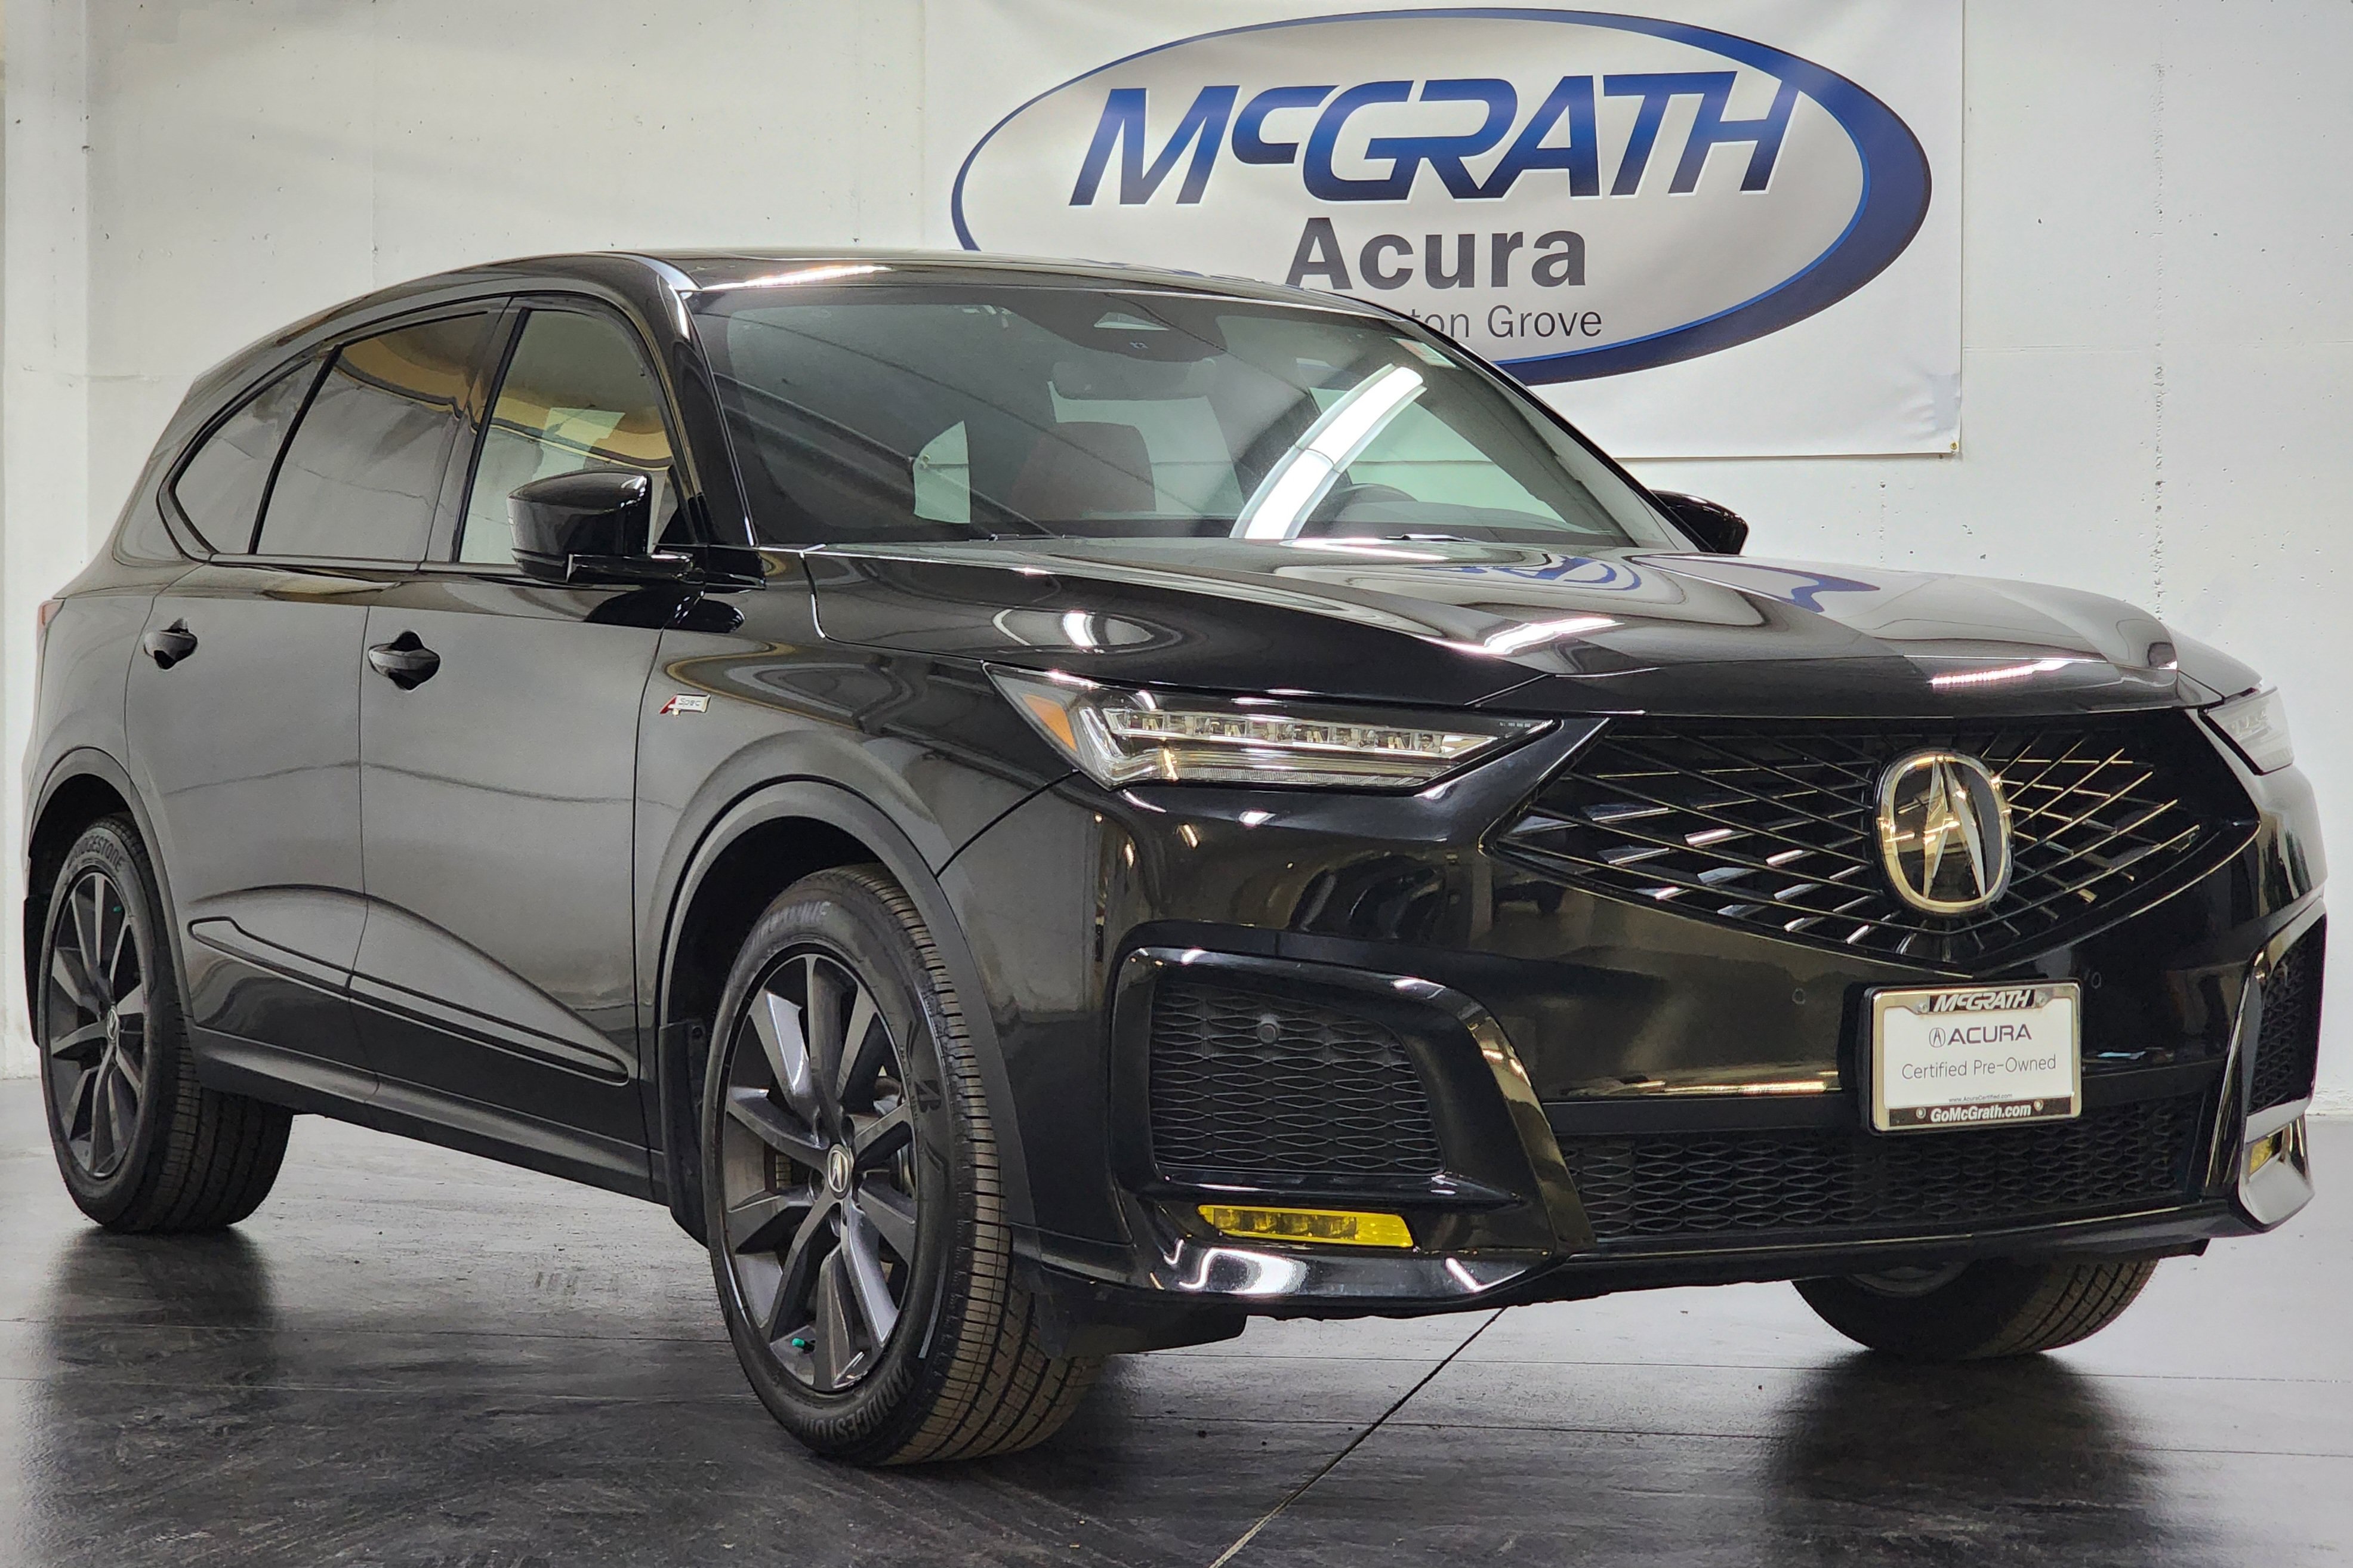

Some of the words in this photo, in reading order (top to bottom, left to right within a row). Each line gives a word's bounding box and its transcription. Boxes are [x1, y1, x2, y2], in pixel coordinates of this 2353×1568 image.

[1287, 217, 1587, 291] Acura
[1488, 304, 1603, 338] Grove
[1947, 1024, 2033, 1046] ACURA
[1902, 1061, 1967, 1080] Certified
[1973, 1054, 2056, 1075] Pre-Owned
[1930, 1104, 2031, 1122] GoMcGrath.com
